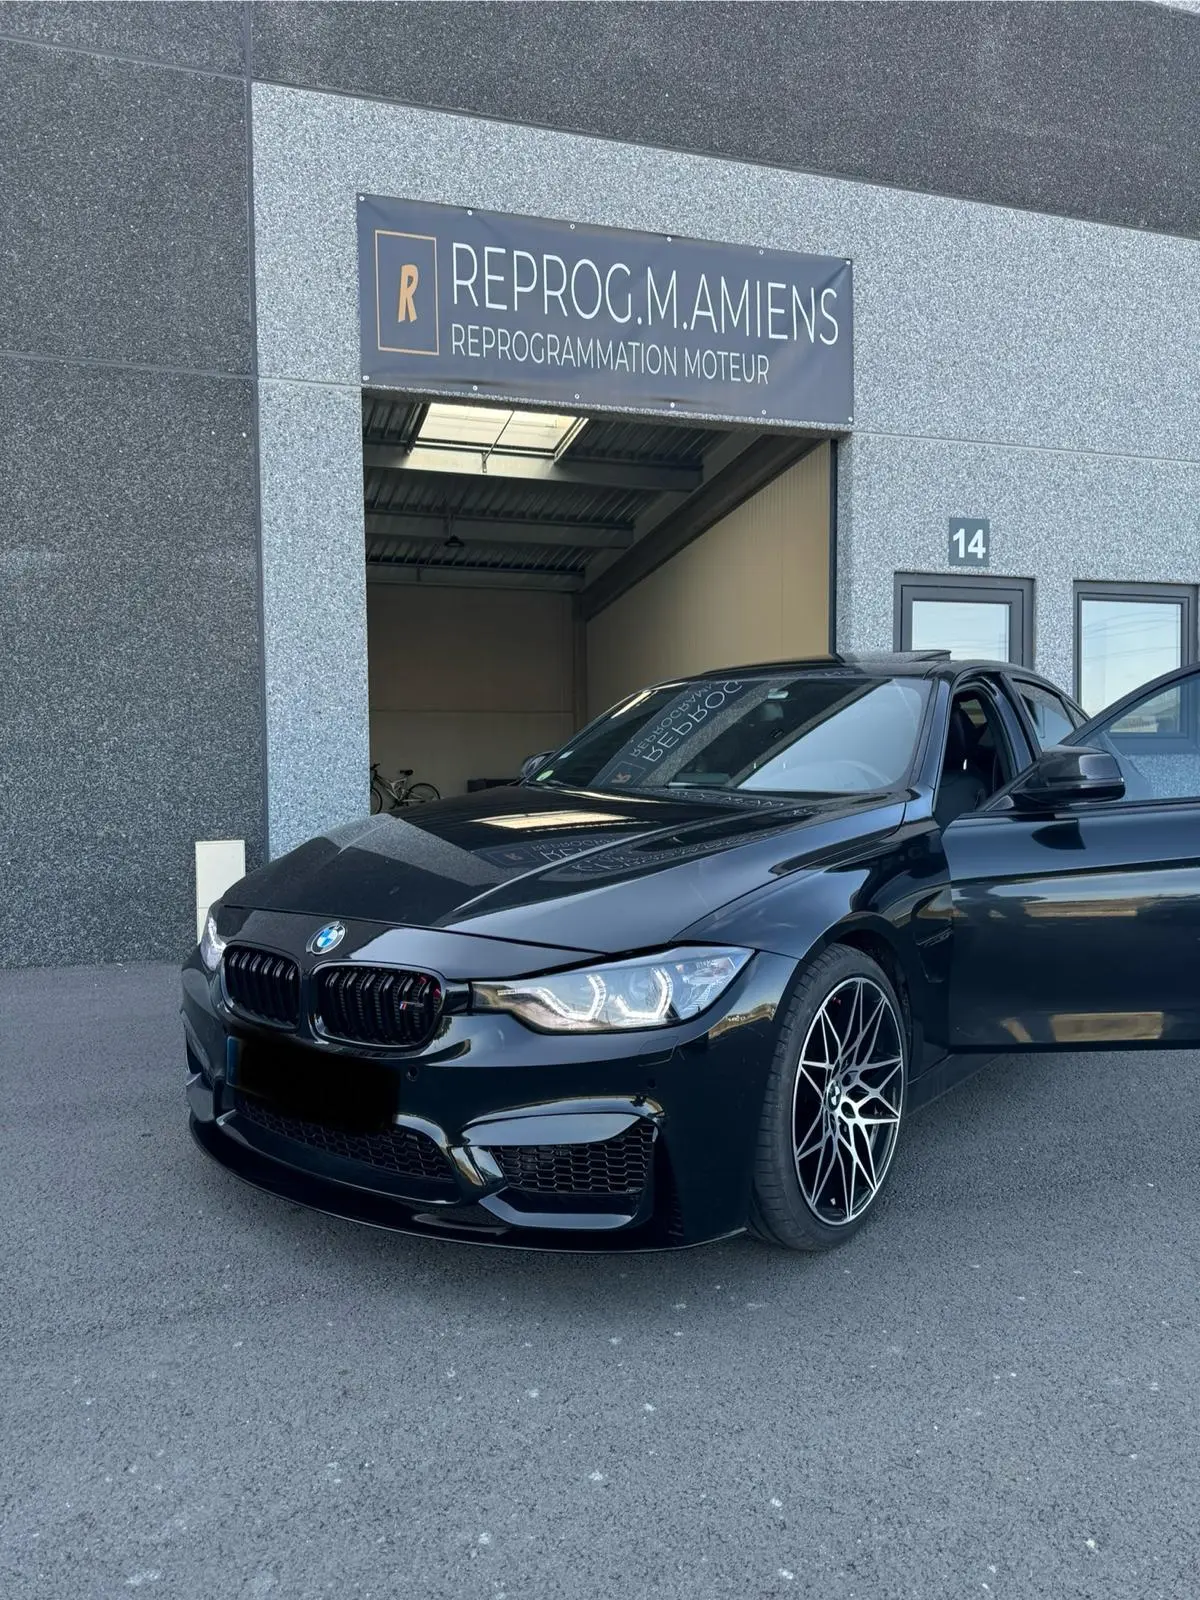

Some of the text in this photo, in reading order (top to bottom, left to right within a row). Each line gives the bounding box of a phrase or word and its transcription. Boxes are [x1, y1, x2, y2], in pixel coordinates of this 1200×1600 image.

[397, 263, 419, 324] R
[452, 241, 840, 346] REPROG.M.AMIENS
[452, 323, 770, 385] REPROGRAMMATION MOTEUR
[953, 528, 986, 559] 14
